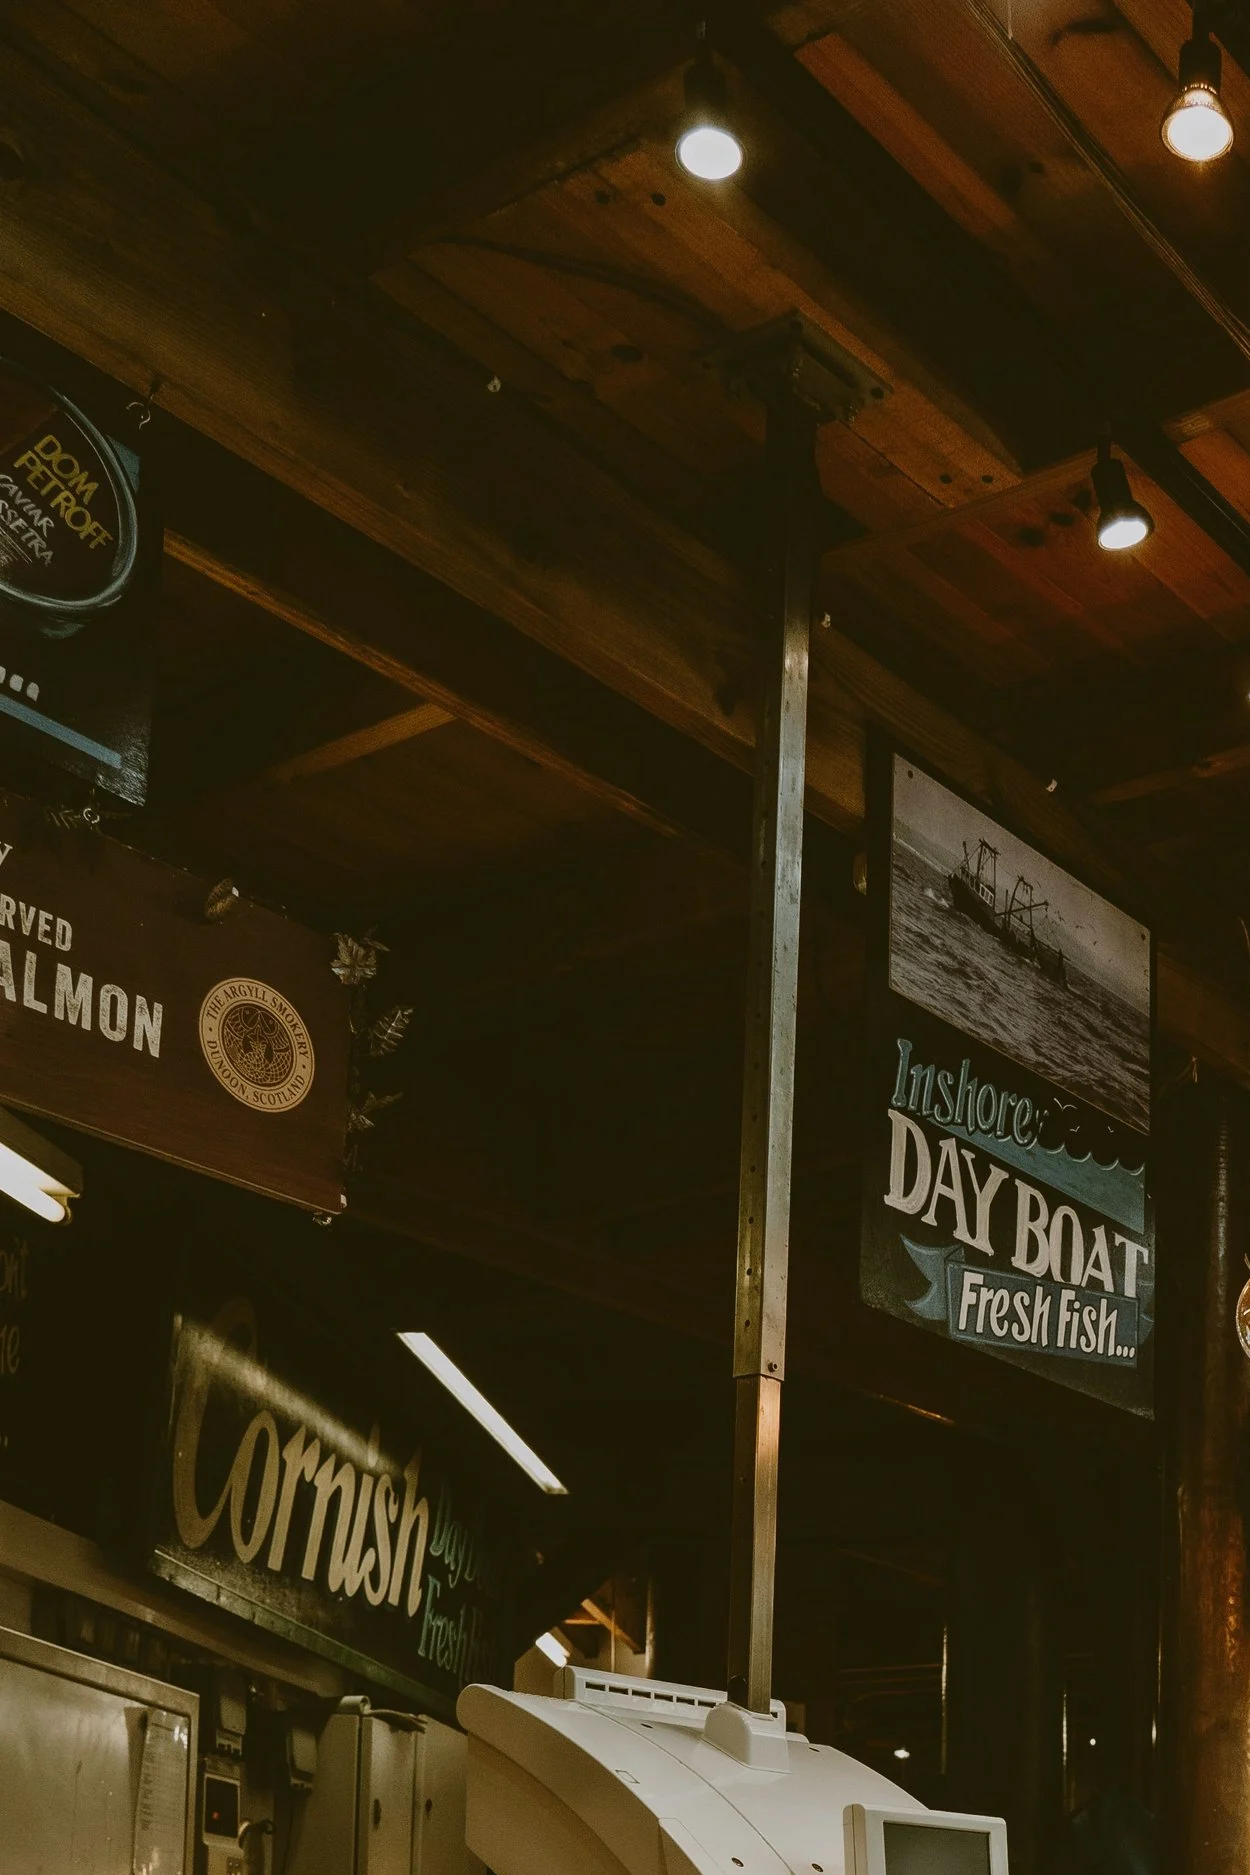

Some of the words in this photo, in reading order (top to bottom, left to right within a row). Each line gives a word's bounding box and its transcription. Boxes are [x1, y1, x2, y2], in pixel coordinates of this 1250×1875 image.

[13, 450, 114, 549] PETROFF
[34, 434, 99, 505] DOM
[206, 994, 224, 1020] THE
[223, 984, 268, 1003] ARGYLL
[270, 996, 309, 1059] SMOKERY
[253, 1075, 306, 1106] SCOTLAND
[884, 1109, 1009, 1256] DAY
[1011, 1179, 1149, 1297] BOAT
[958, 1271, 1050, 1347] Fresh
[173, 1298, 430, 1618] Cornish
